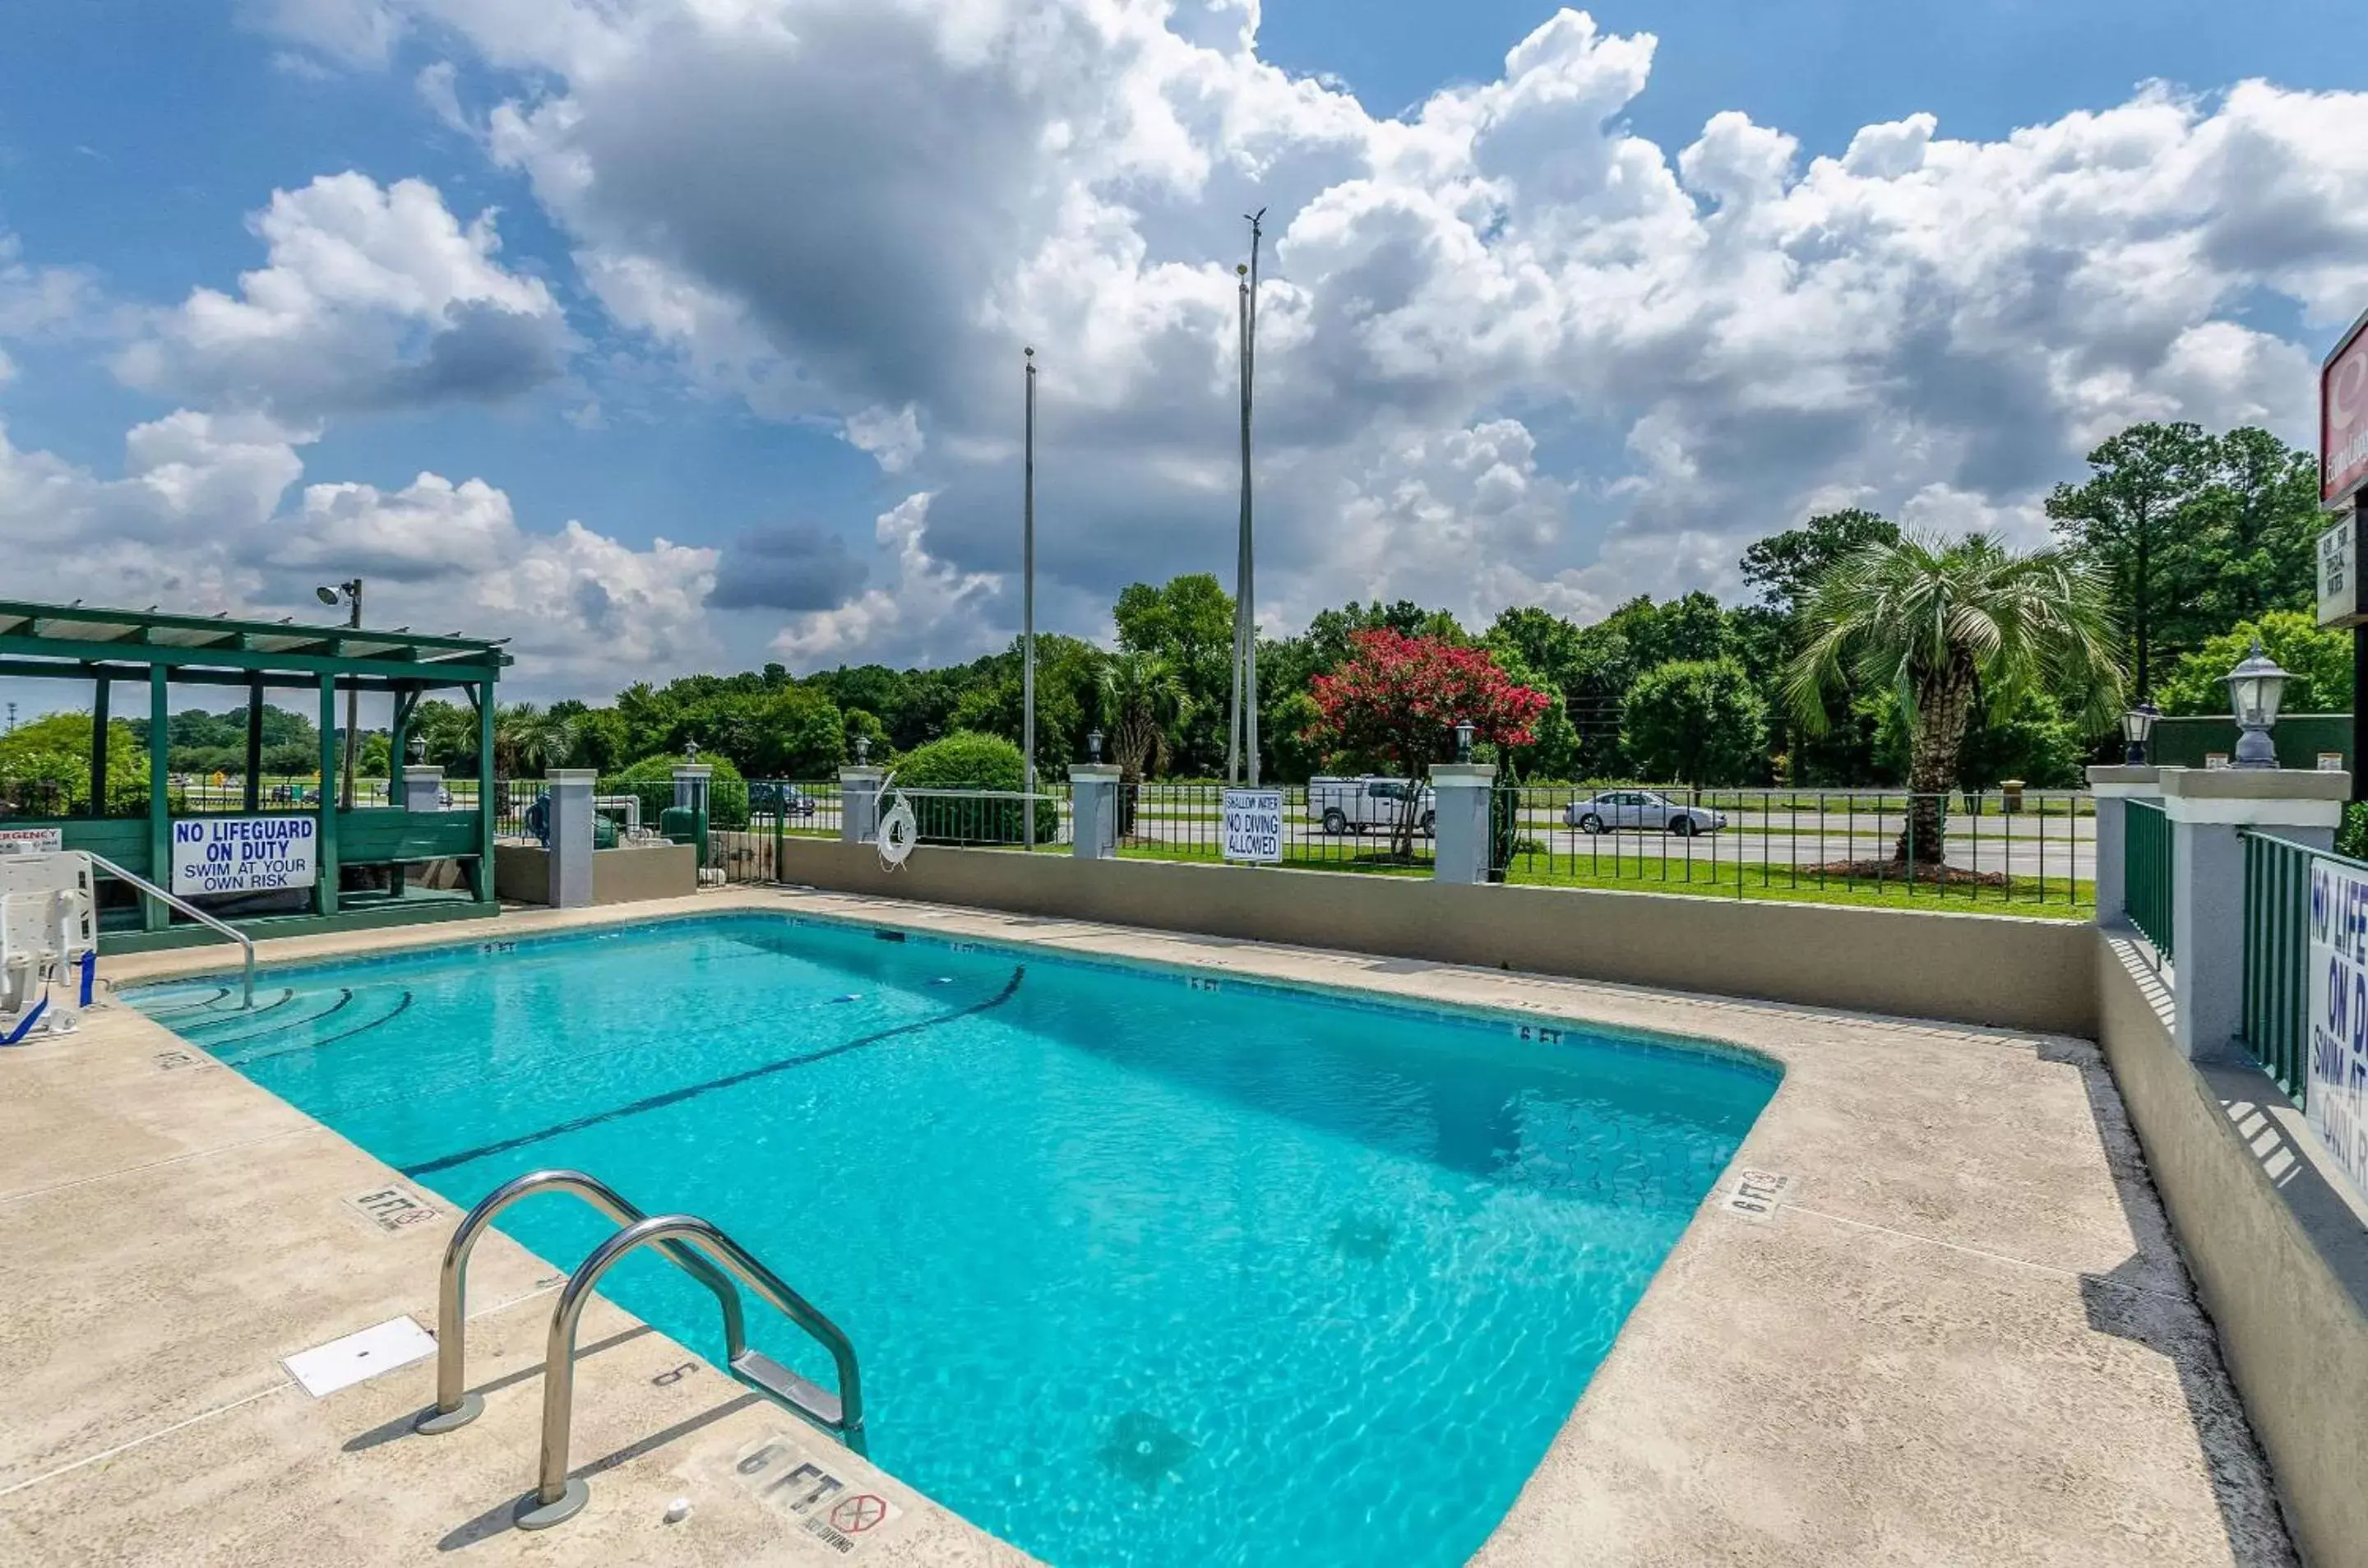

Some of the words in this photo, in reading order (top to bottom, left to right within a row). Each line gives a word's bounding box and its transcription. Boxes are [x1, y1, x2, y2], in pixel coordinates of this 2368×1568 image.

[177, 823, 203, 842] NO
[213, 821, 312, 841] LIFEGUARD
[1227, 813, 1241, 832] NO
[1245, 815, 1278, 834] DIVING
[0, 830, 58, 839] RGENCY
[1228, 835, 1276, 855] ALLOWED
[206, 843, 232, 863] ON
[243, 840, 289, 860] DUTY
[185, 863, 229, 878] SWIM
[238, 862, 254, 874] AT
[265, 859, 306, 873] YOUR
[205, 877, 243, 890] OWN
[252, 873, 288, 887] RISK
[2312, 867, 2329, 943] NO
[2329, 955, 2348, 1042] ON
[1539, 1028, 1562, 1044] FT
[2314, 1024, 2343, 1100] SWIM
[2348, 1059, 2368, 1120] AT
[2324, 1091, 2352, 1172] OWN
